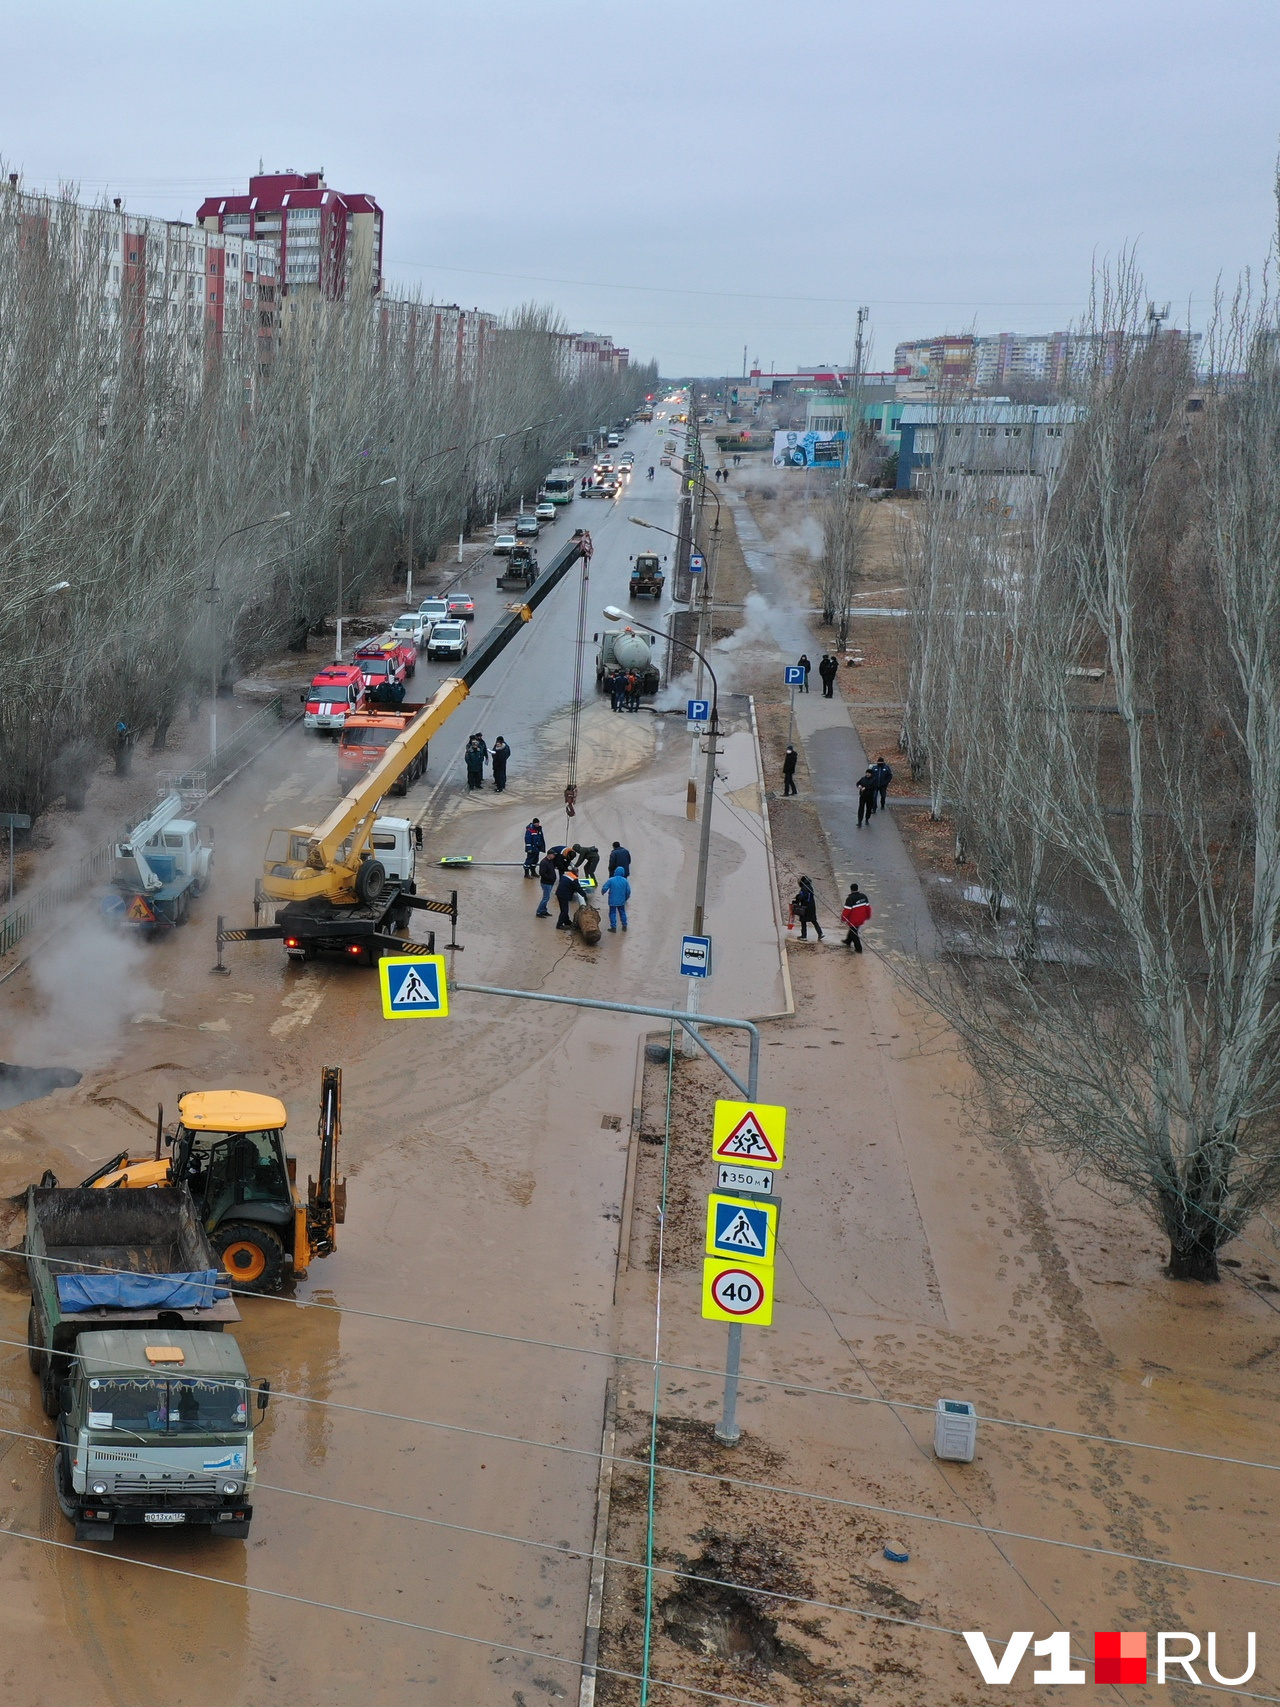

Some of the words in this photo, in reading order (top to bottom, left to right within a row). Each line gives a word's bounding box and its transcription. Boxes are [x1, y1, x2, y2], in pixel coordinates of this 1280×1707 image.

[789, 668, 800, 683] P
[692, 702, 705, 718] P
[729, 1172, 754, 1185] 350
[721, 1282, 752, 1302] 40
